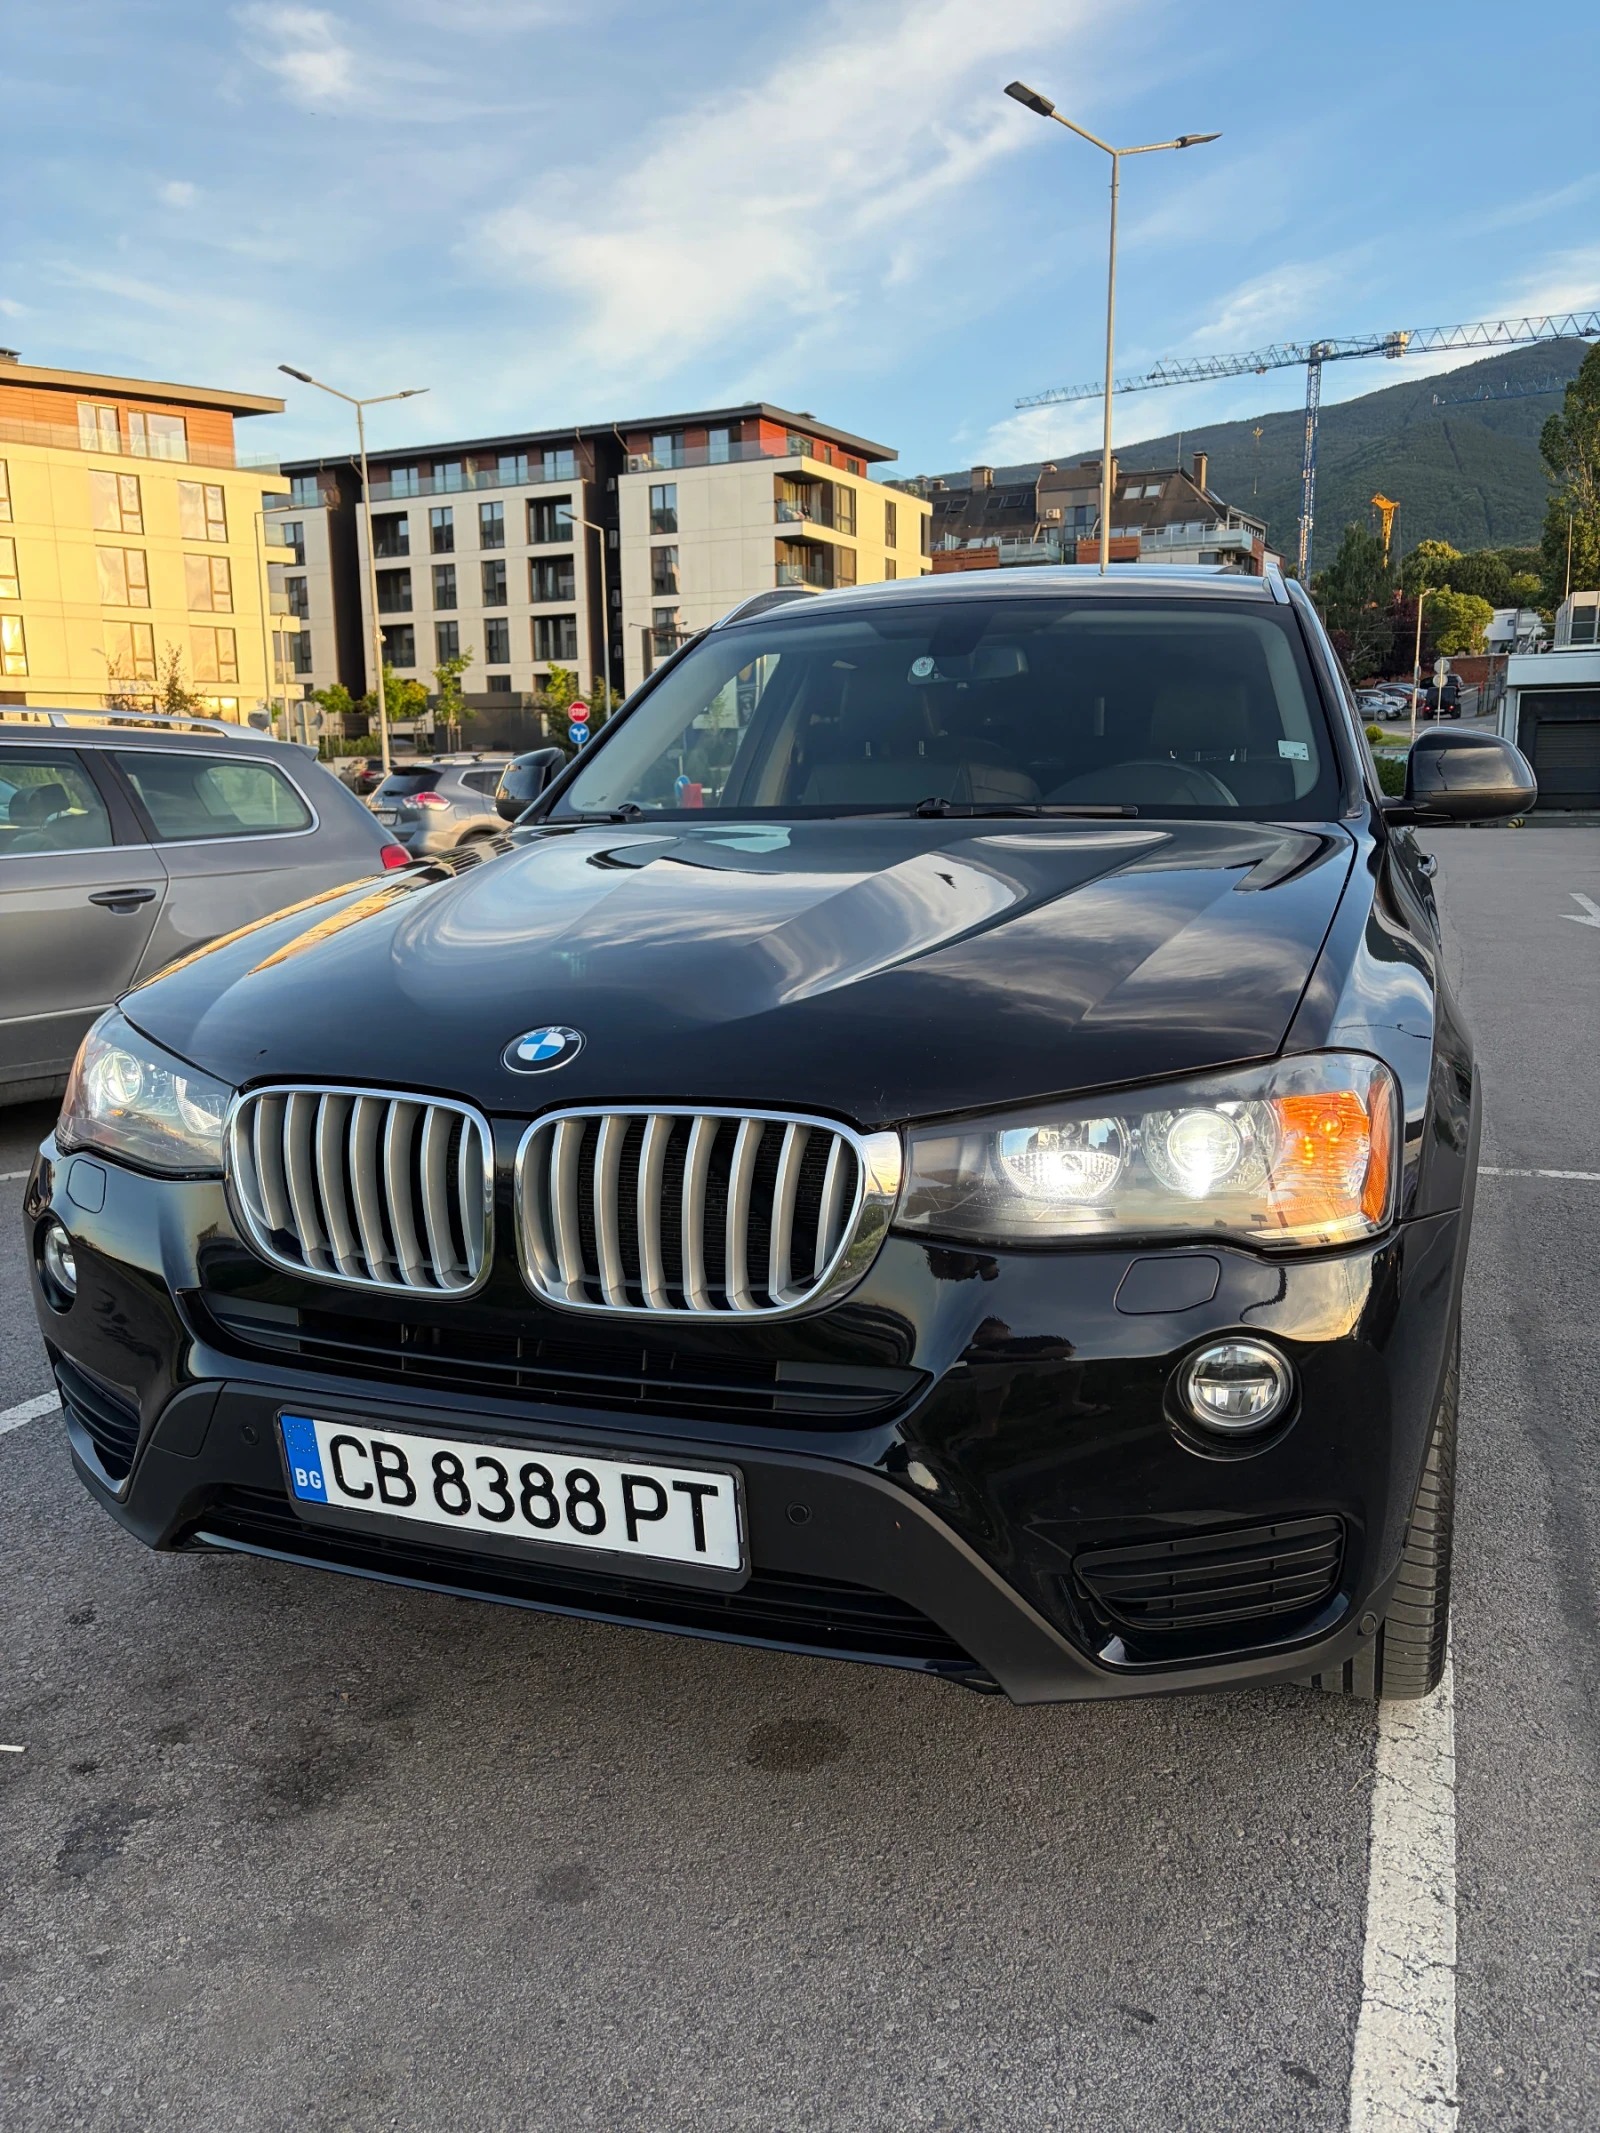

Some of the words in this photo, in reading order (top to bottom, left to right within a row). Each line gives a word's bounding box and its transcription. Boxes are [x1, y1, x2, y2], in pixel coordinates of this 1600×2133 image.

[570, 708, 588, 717] STOP
[295, 1467, 322, 1490] BG
[330, 1434, 417, 1507] CB
[432, 1450, 607, 1537] 8388
[621, 1474, 719, 1553] PT
